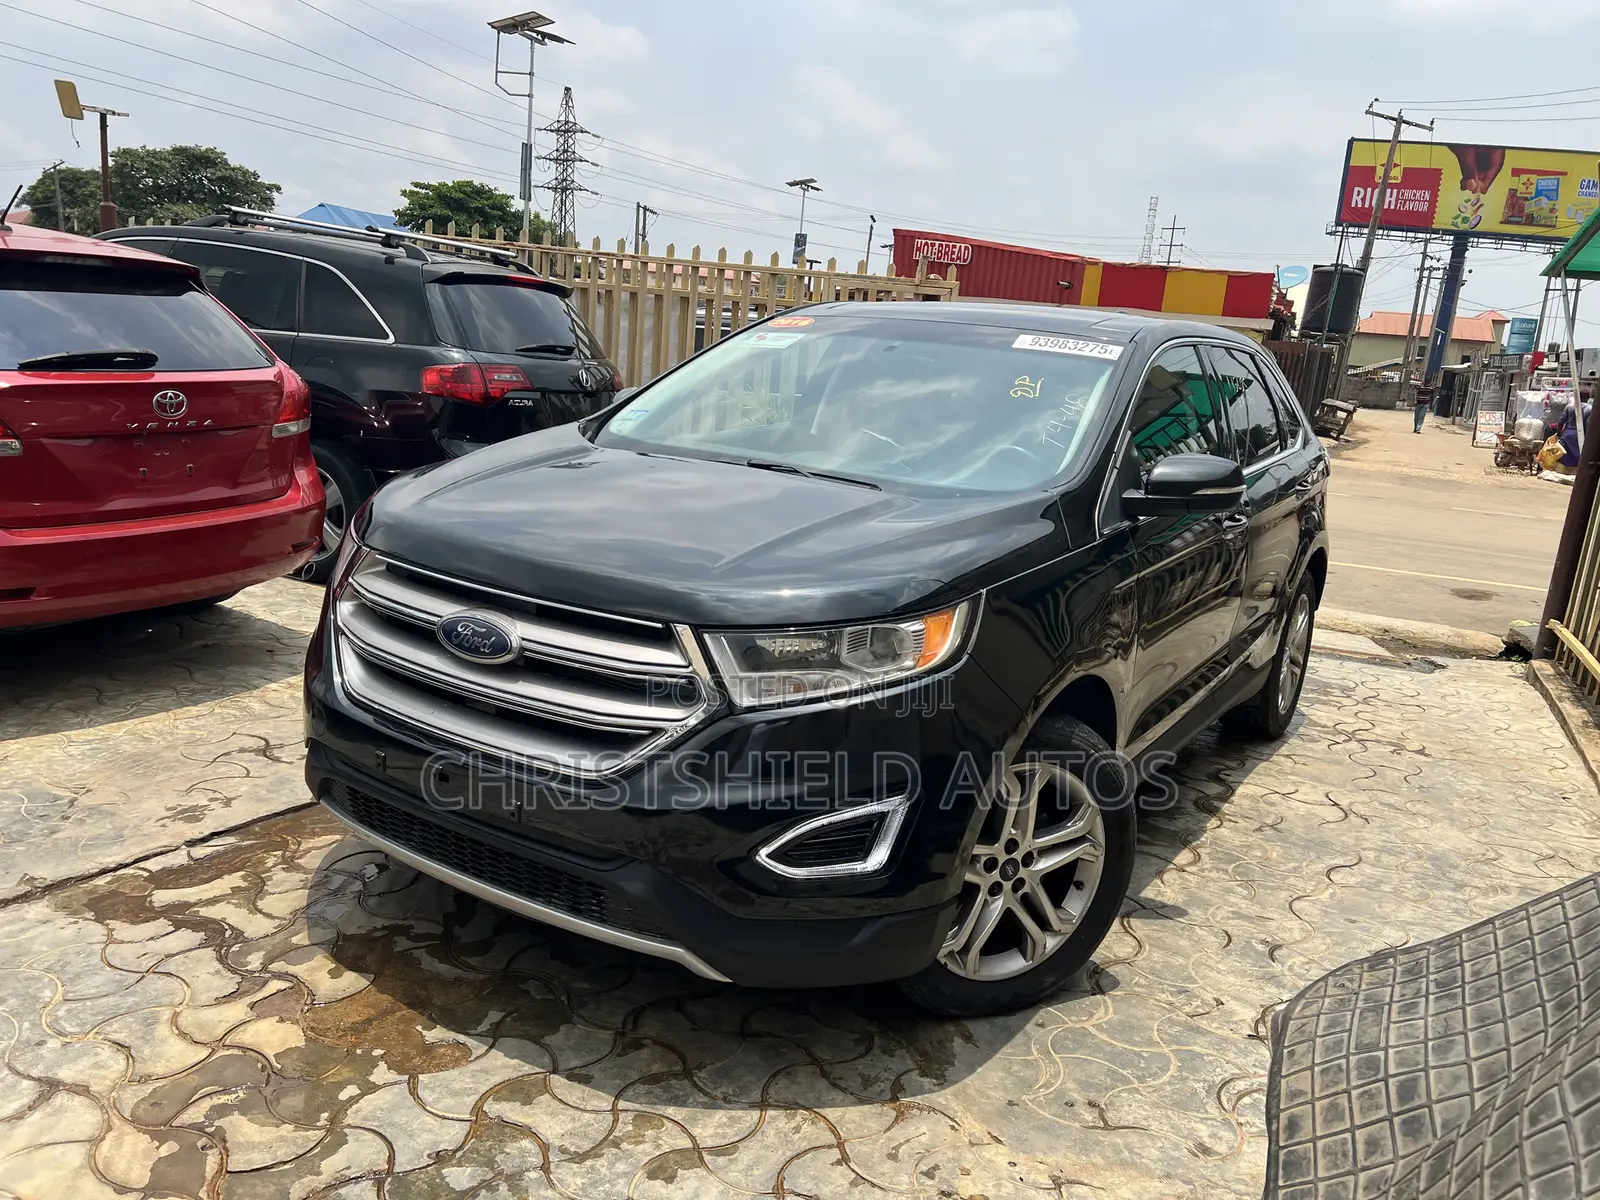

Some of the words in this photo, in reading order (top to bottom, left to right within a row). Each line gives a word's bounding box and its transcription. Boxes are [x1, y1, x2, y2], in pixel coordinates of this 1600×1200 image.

[1399, 188, 1431, 201] CHICKEN
[1397, 200, 1430, 212] FLAVOUR
[508, 399, 534, 407] ACURA
[127, 419, 214, 429] VENZA
[452, 621, 496, 653] Ford
